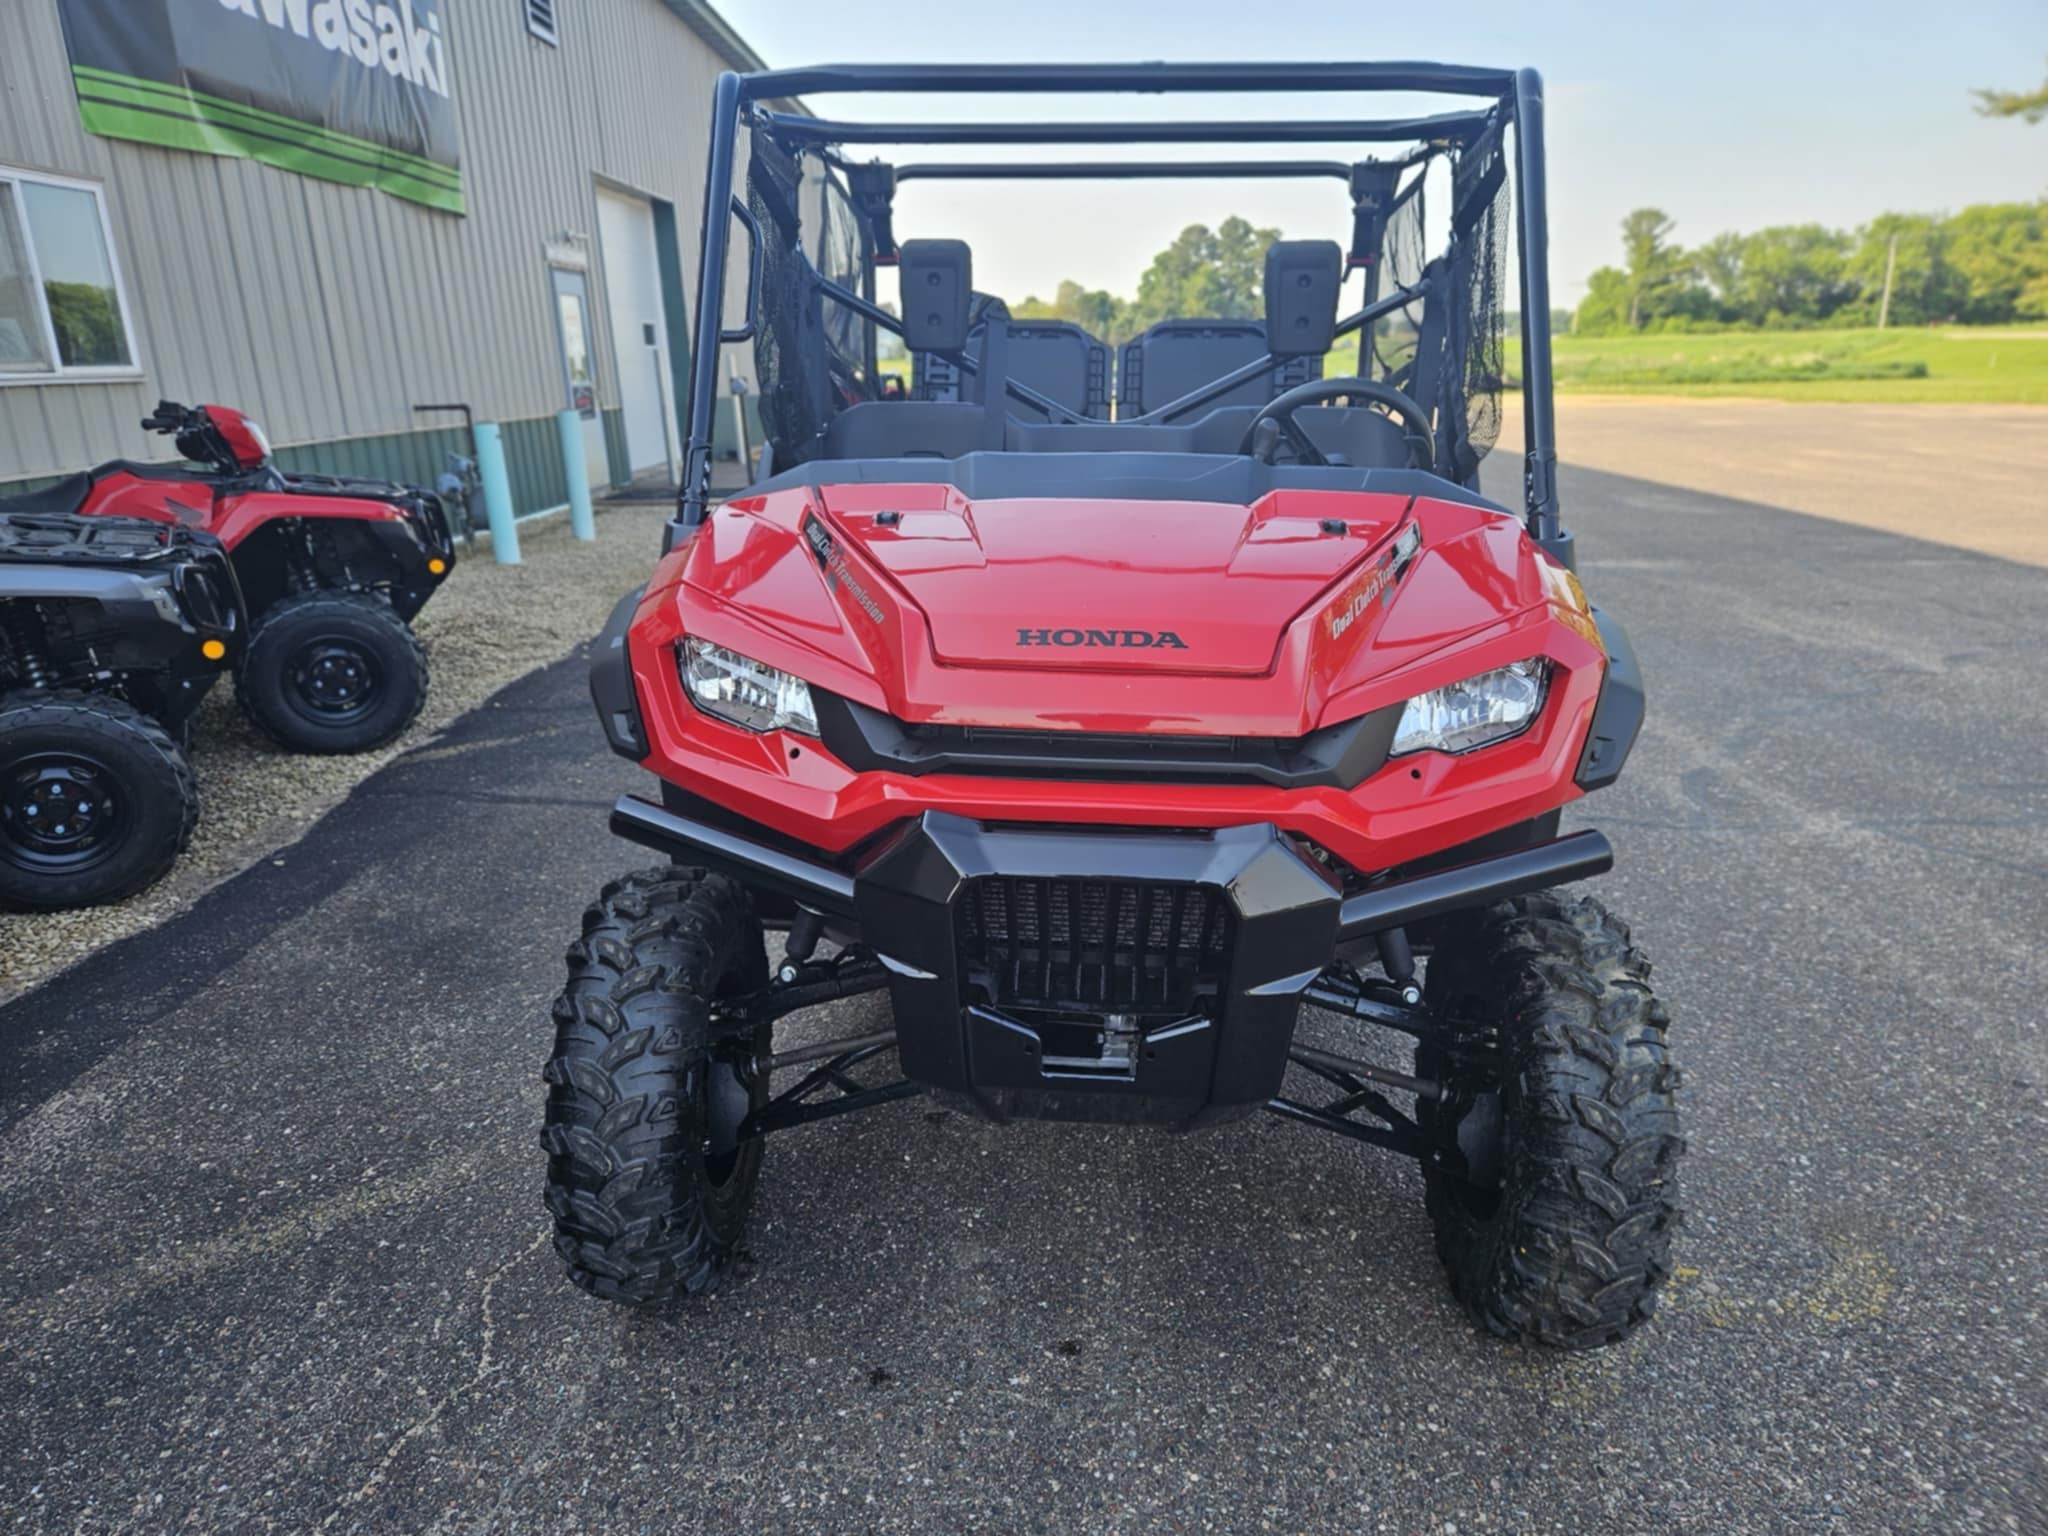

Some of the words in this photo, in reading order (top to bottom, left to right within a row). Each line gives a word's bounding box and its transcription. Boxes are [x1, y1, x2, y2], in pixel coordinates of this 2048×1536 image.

[819, 537, 841, 567] Clutch
[835, 559, 885, 624] Transmission
[1332, 603, 1354, 640] Dual
[1354, 578, 1379, 617] Clutch
[1016, 629, 1189, 649] HONDA
